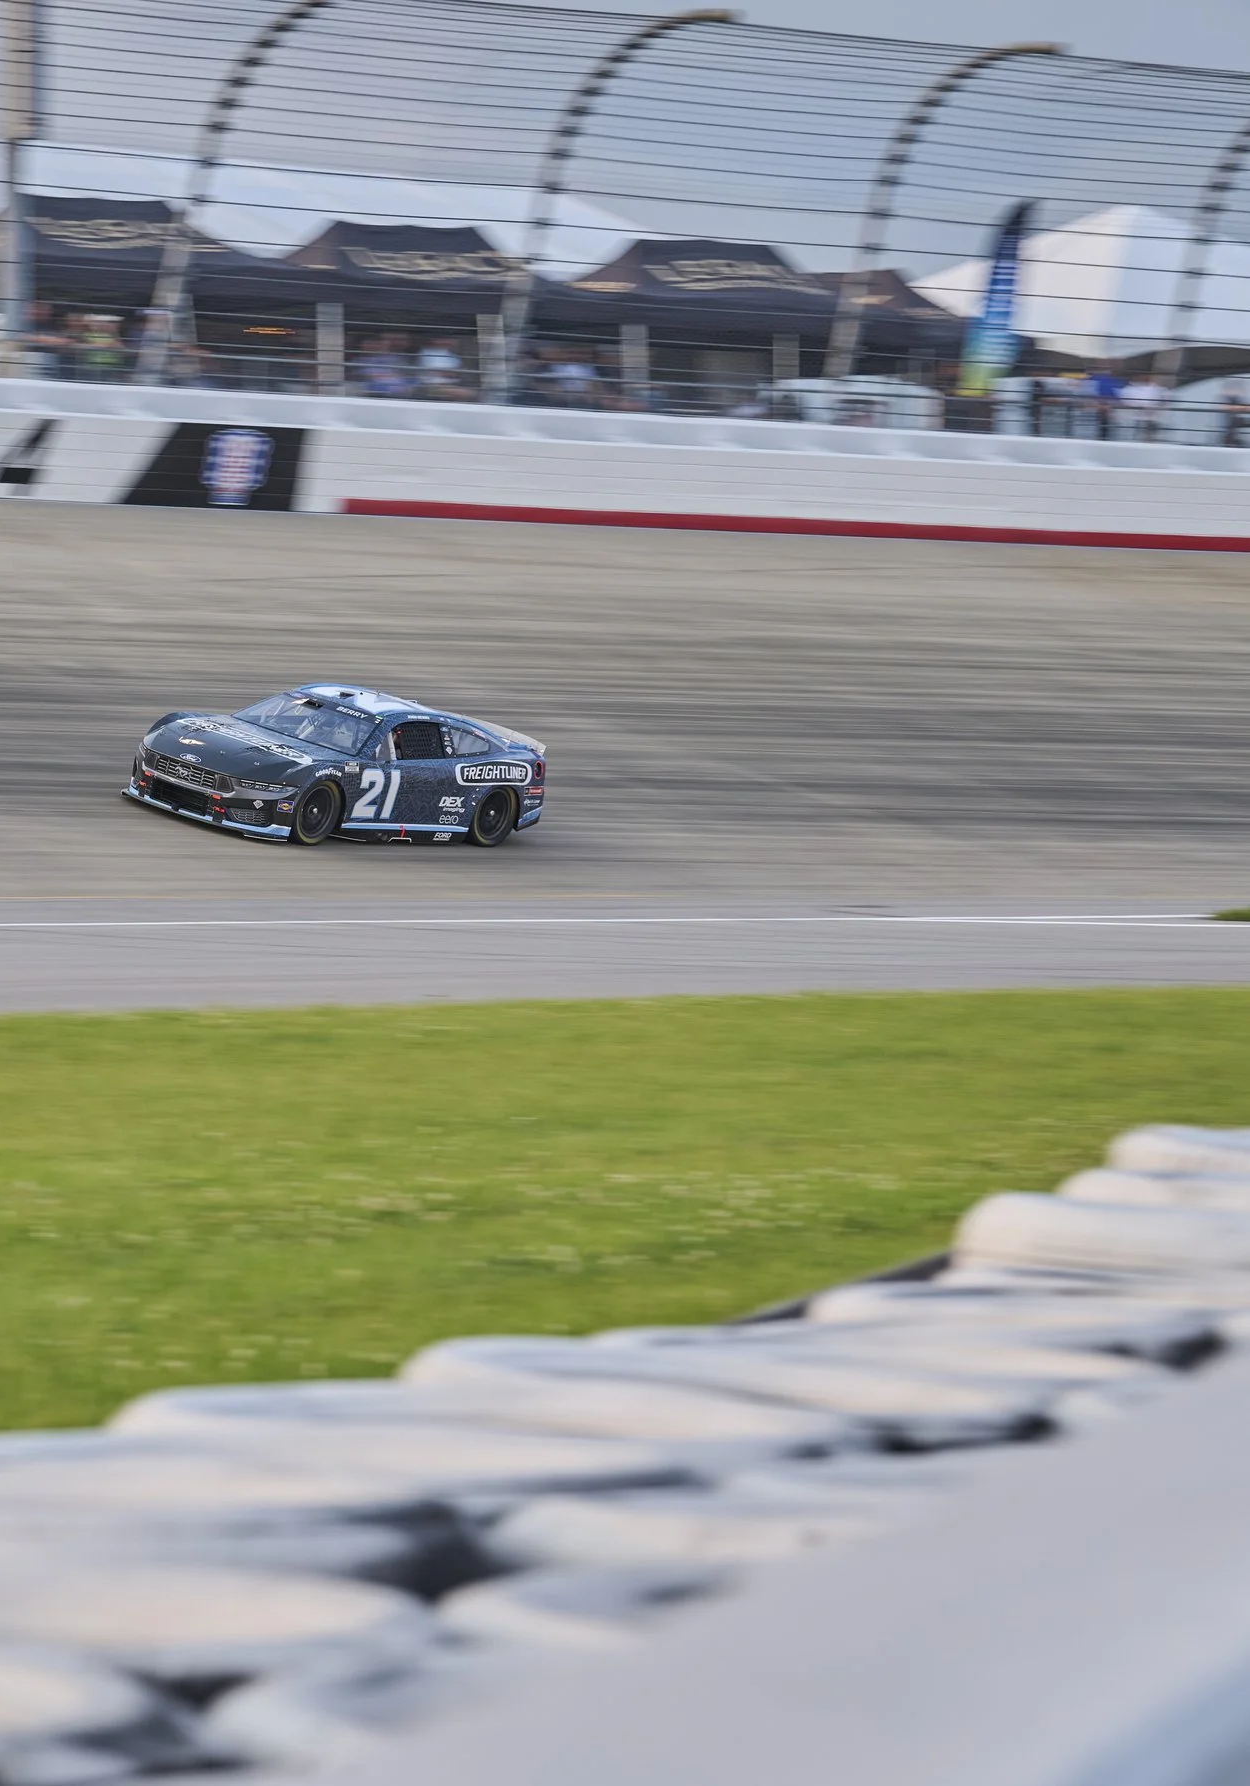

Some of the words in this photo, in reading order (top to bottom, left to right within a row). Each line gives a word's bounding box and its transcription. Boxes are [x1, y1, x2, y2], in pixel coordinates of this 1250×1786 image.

[336, 706, 368, 719] BERRY
[315, 767, 342, 777] GOODYEAR
[463, 765, 527, 780] FREIGHTLINER
[350, 768, 401, 819] 21
[439, 797, 465, 807] DEX
[439, 815, 459, 824] eero
